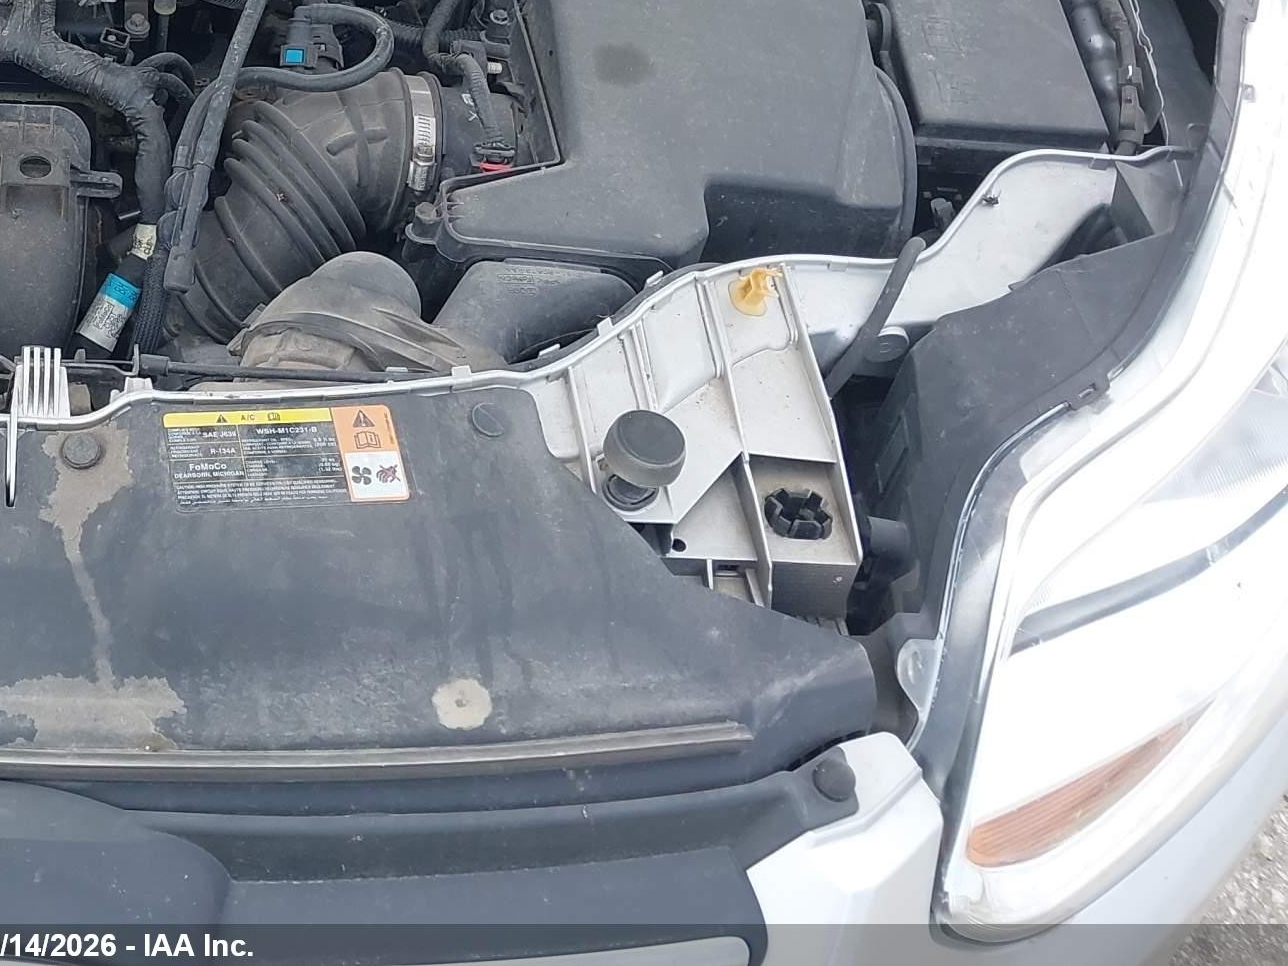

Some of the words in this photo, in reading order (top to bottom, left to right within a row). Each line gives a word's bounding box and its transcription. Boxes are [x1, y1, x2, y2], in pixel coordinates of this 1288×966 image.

[240, 414, 256, 422] A/C
[210, 447, 237, 455] R-134A
[188, 462, 228, 471] FoMoCo
